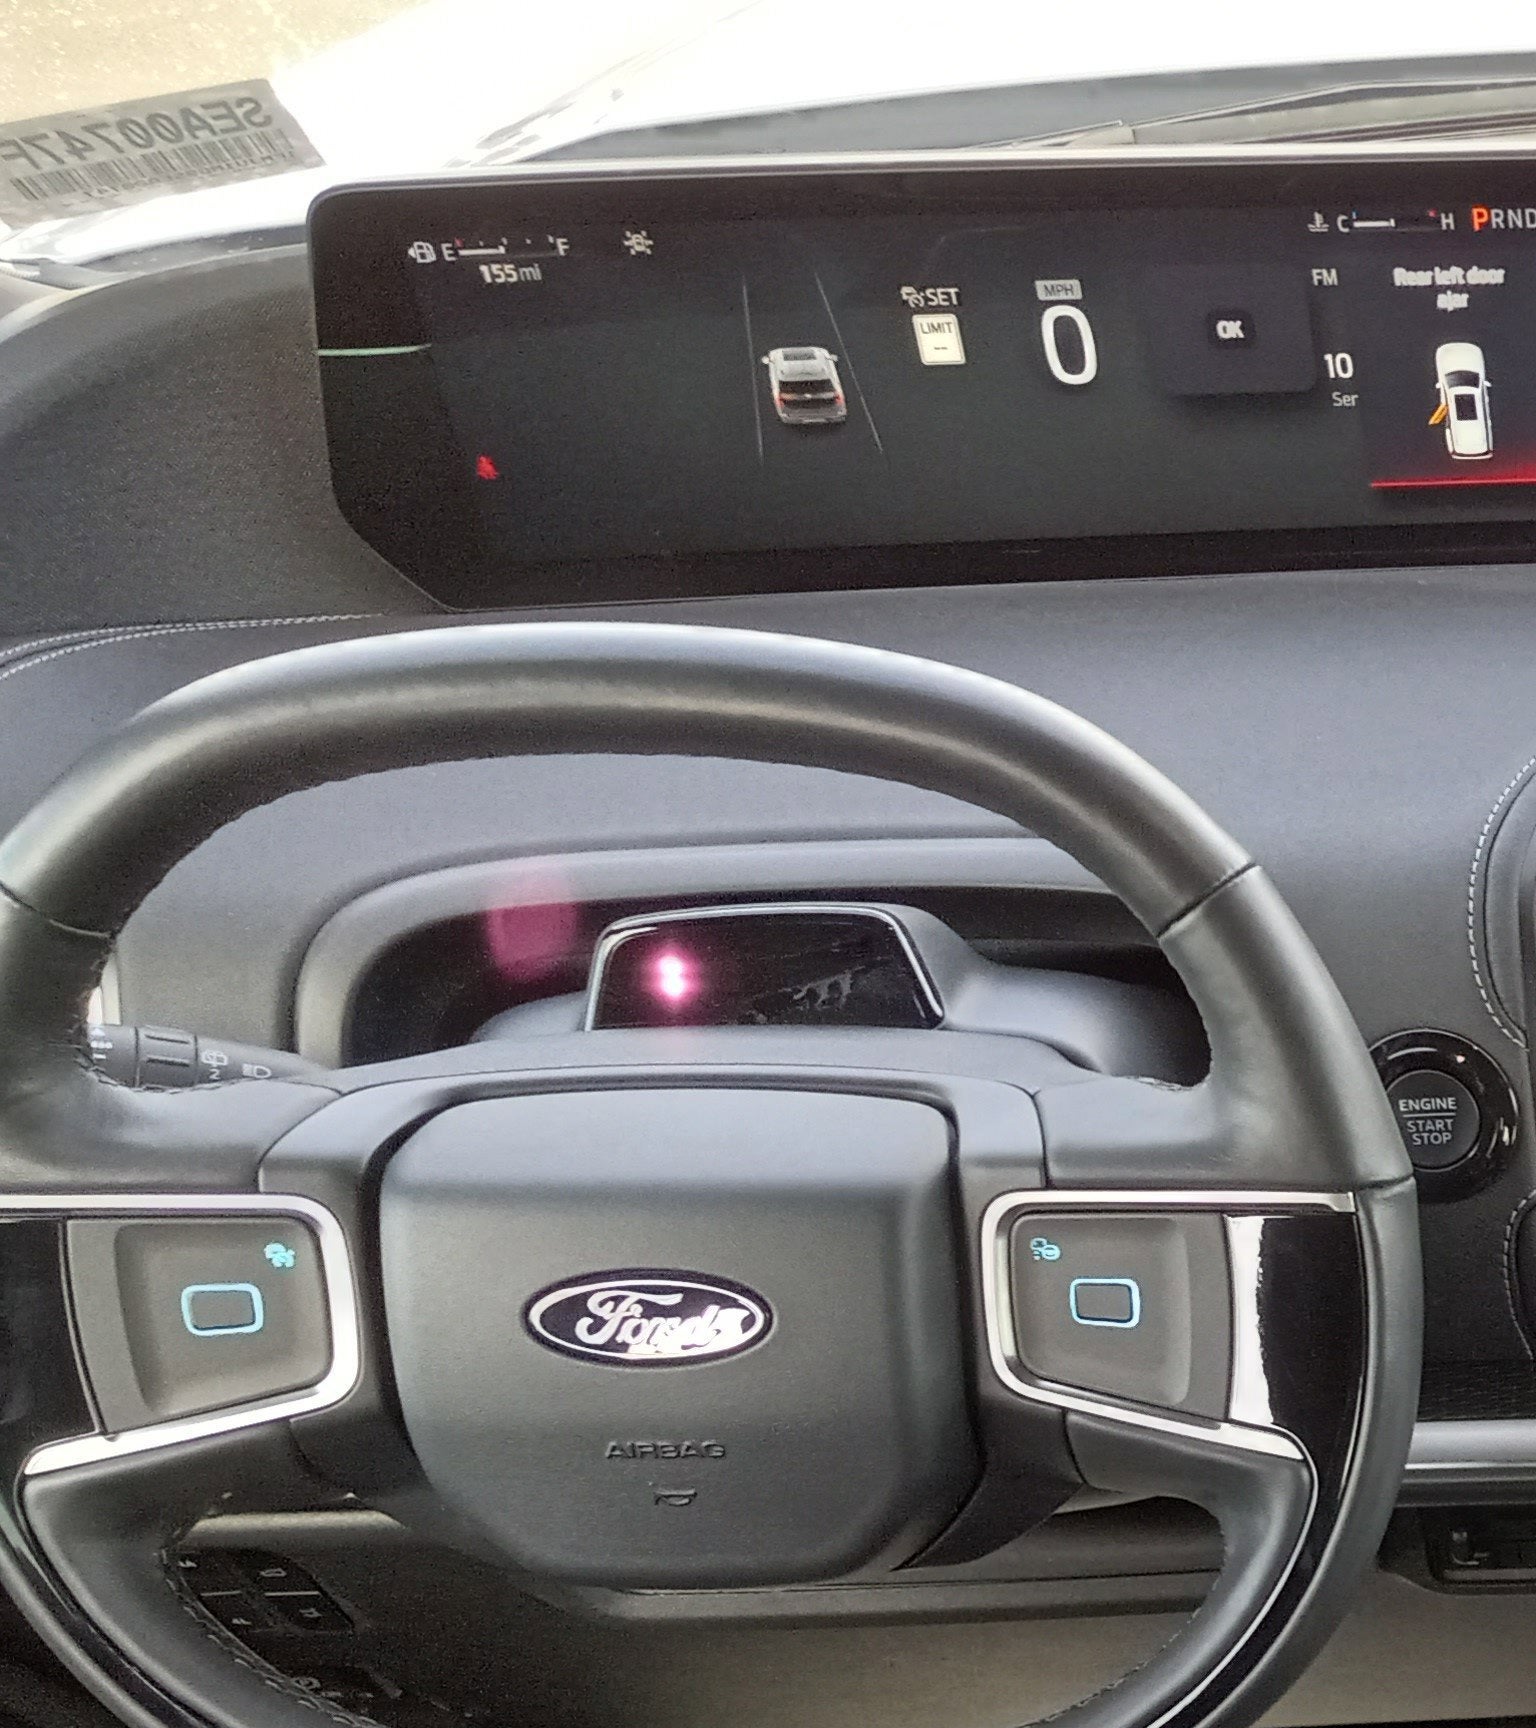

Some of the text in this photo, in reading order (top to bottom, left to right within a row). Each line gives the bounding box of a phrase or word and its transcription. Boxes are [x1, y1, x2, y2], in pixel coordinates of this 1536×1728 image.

[1312, 268, 1338, 286] FM
[1393, 265, 1505, 287] Rear left door
[1044, 284, 1075, 297] MPH
[1436, 290, 1469, 312] ajar
[920, 320, 953, 335] LIMIT
[1216, 320, 1244, 339] OK
[1041, 305, 1097, 385] 0
[1399, 1097, 1457, 1112] ENGINE
[1406, 1119, 1454, 1132] START
[1412, 1132, 1452, 1146] STOP
[604, 1440, 726, 1459] AIRBAG
